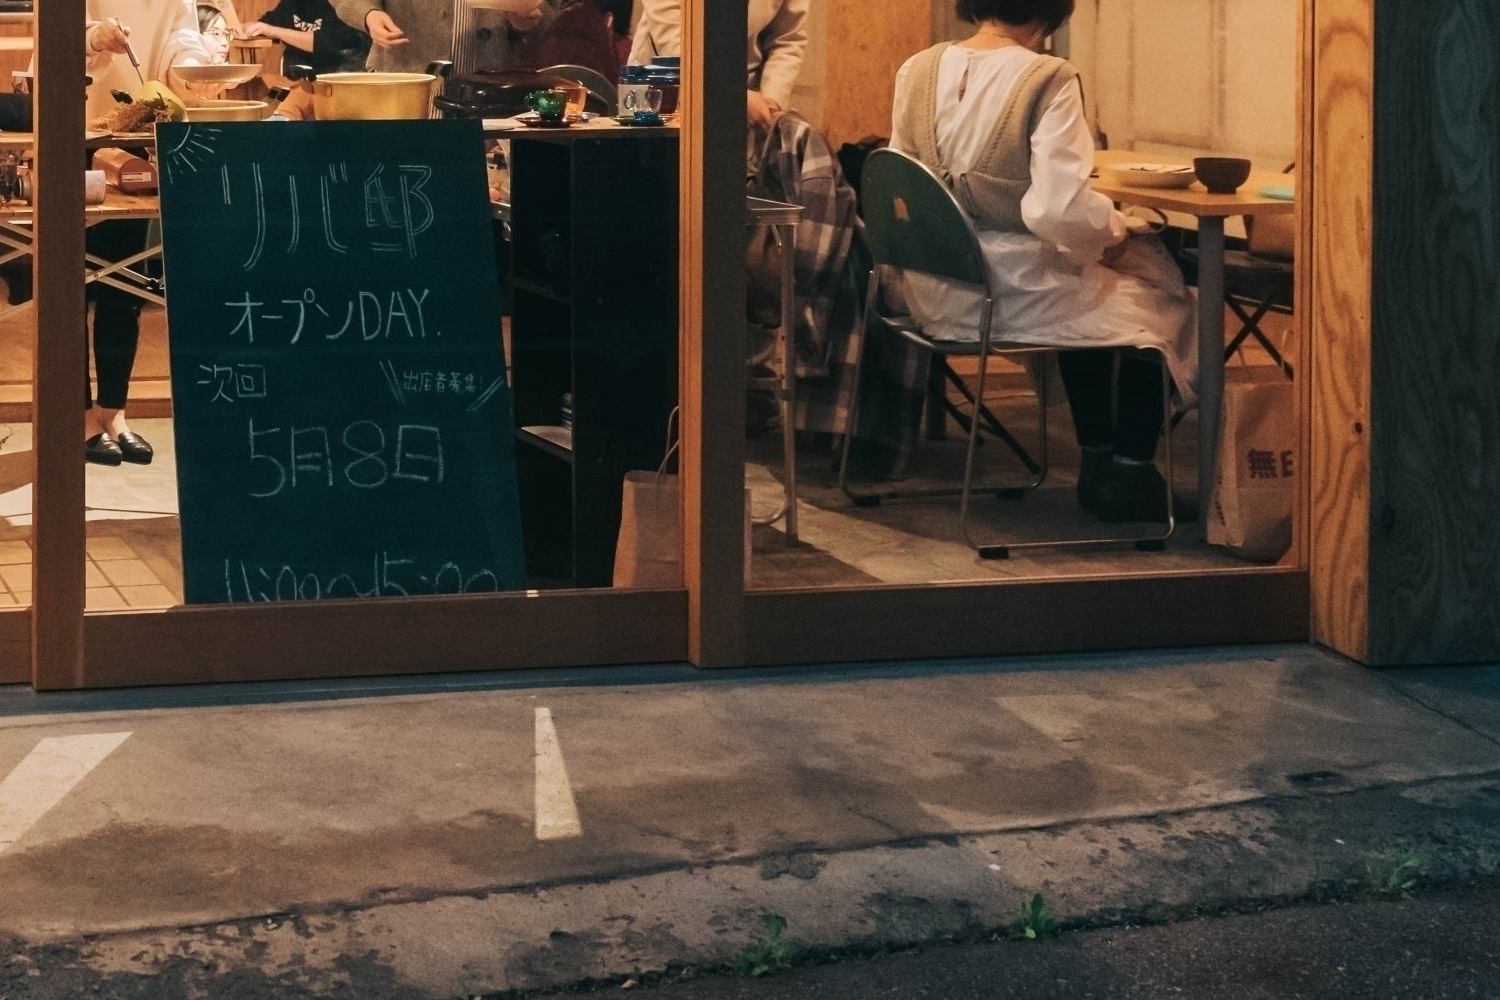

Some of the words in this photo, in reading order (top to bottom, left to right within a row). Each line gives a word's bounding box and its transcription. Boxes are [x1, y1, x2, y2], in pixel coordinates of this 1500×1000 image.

[221, 161, 434, 272] リバ邸
[197, 363, 268, 403] 次回
[248, 416, 445, 498] 5月8日
